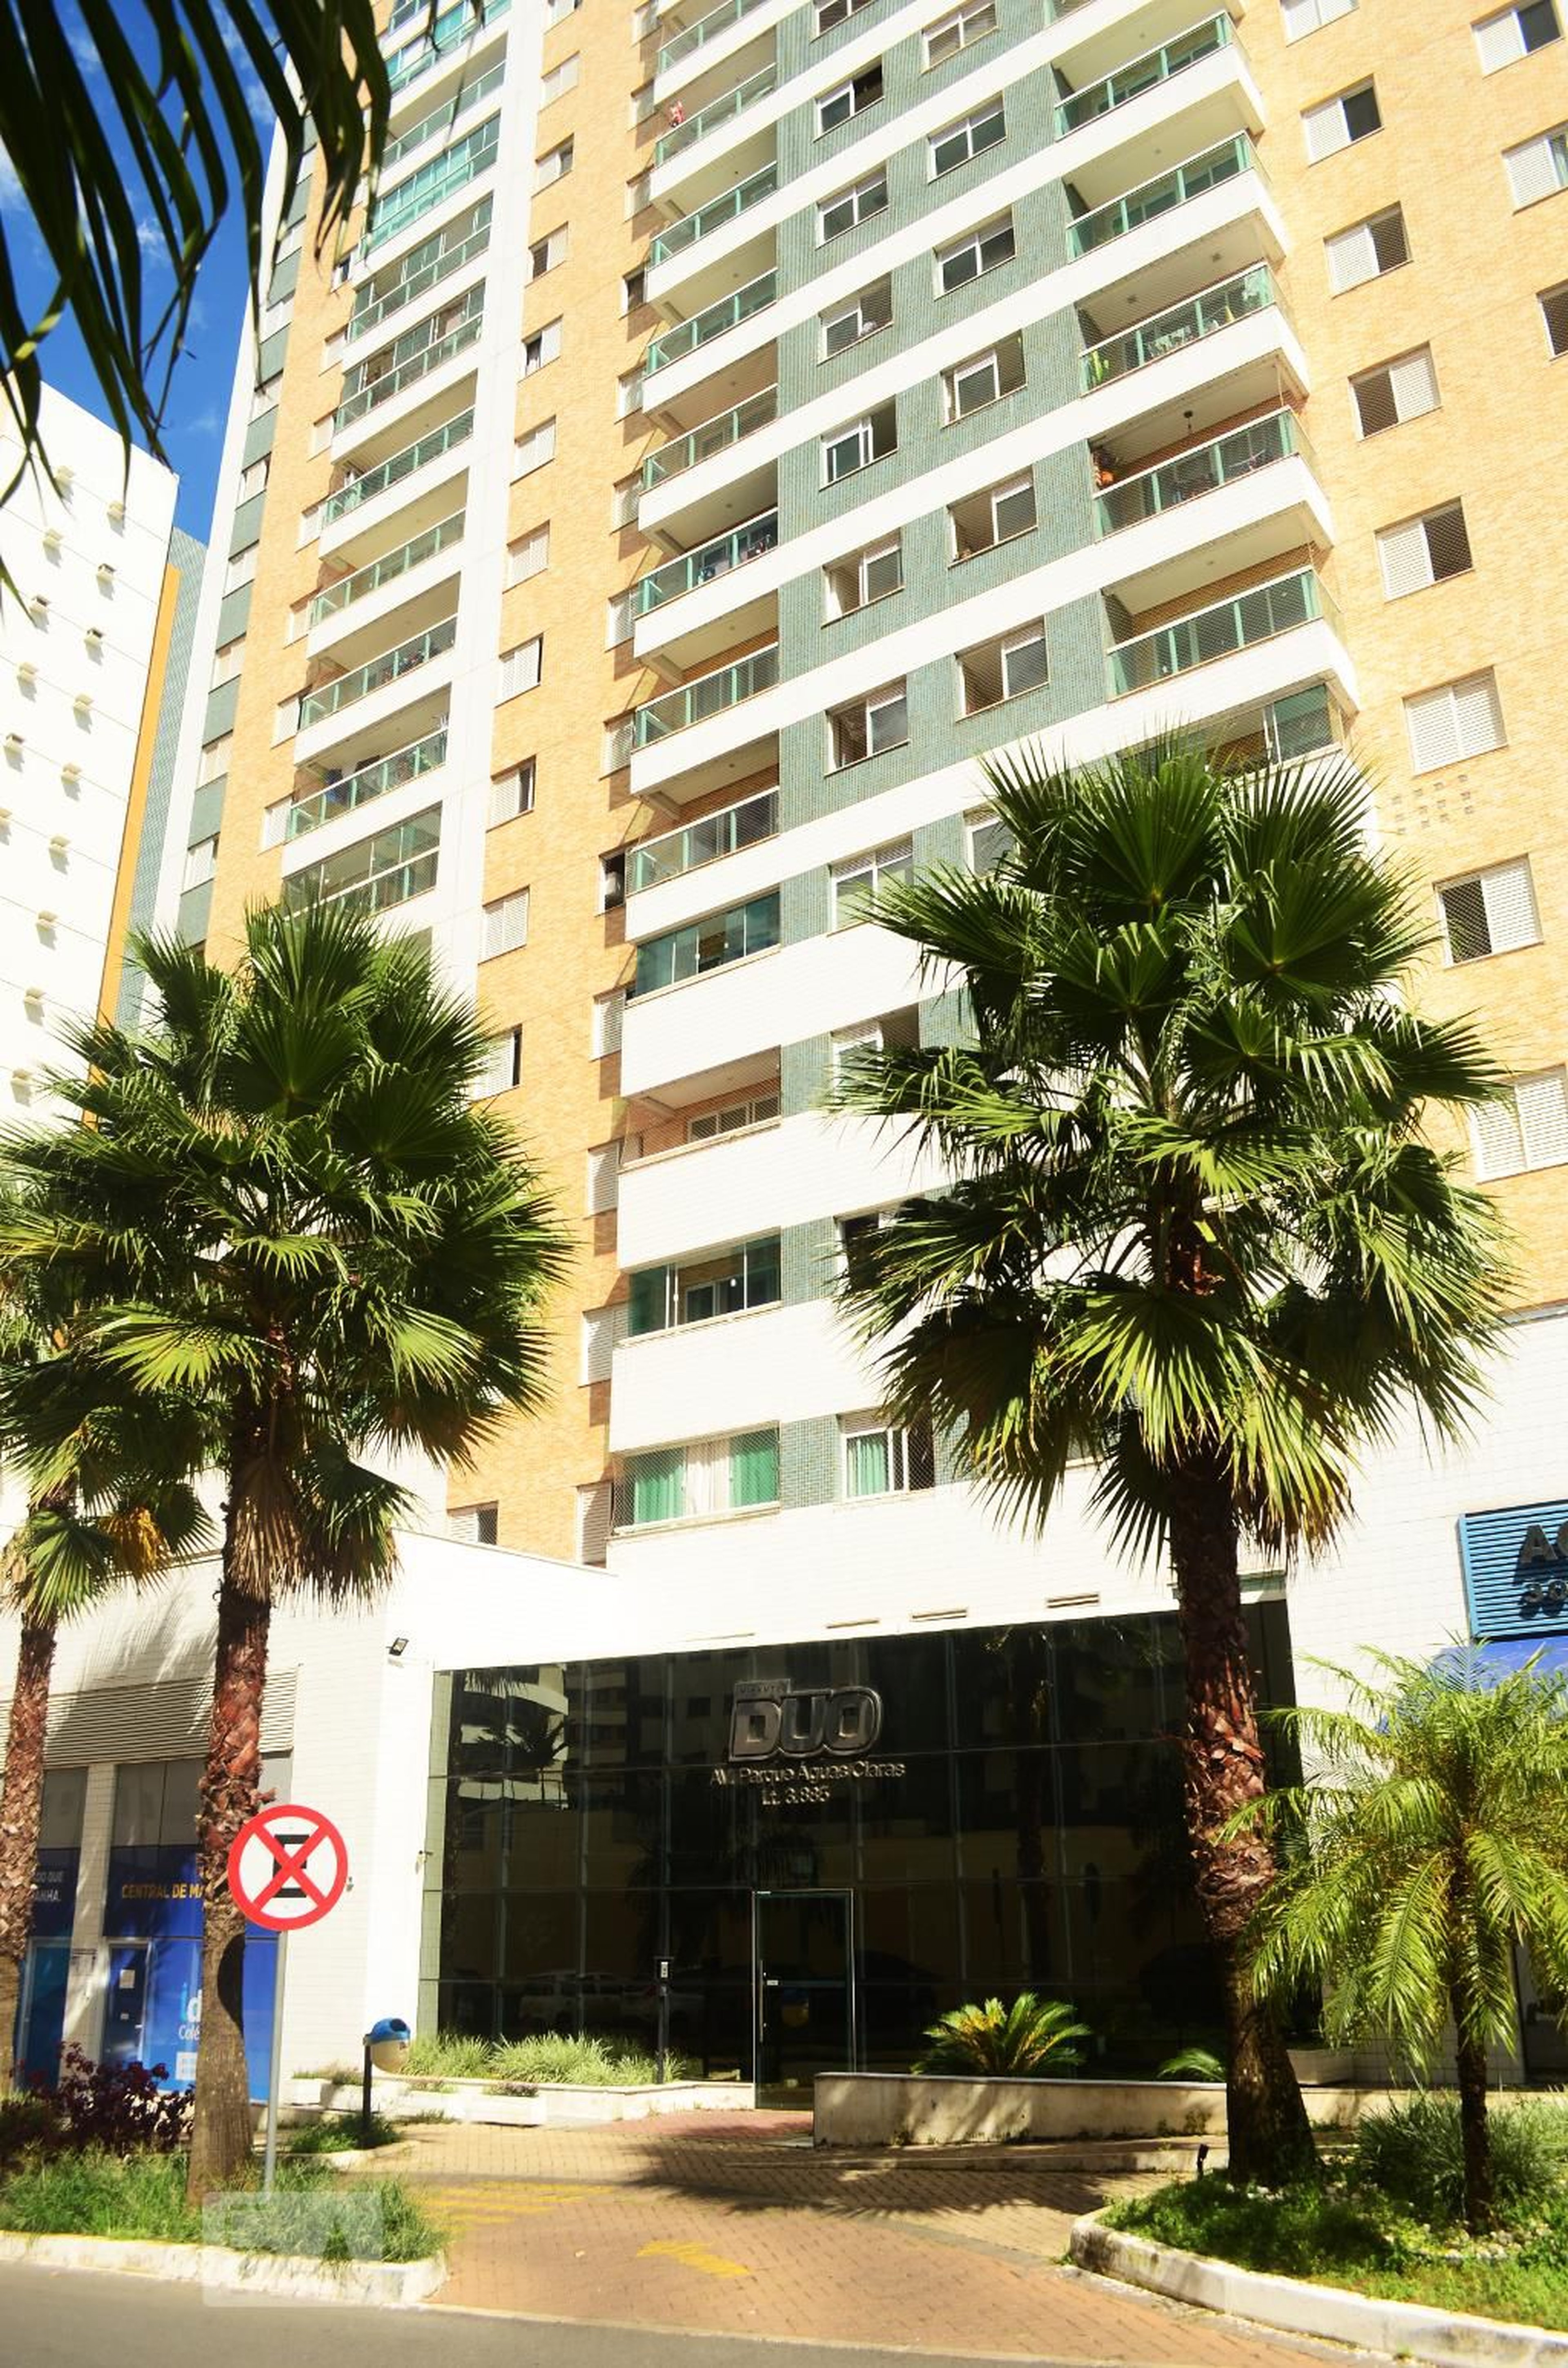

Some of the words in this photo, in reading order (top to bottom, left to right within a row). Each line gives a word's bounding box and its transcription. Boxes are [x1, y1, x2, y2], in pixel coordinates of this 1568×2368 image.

[729, 1686, 881, 1762] DUO
[739, 1767, 795, 1786] Parque
[852, 1760, 906, 1777] Claras
[172, 1883, 187, 1898] DE
